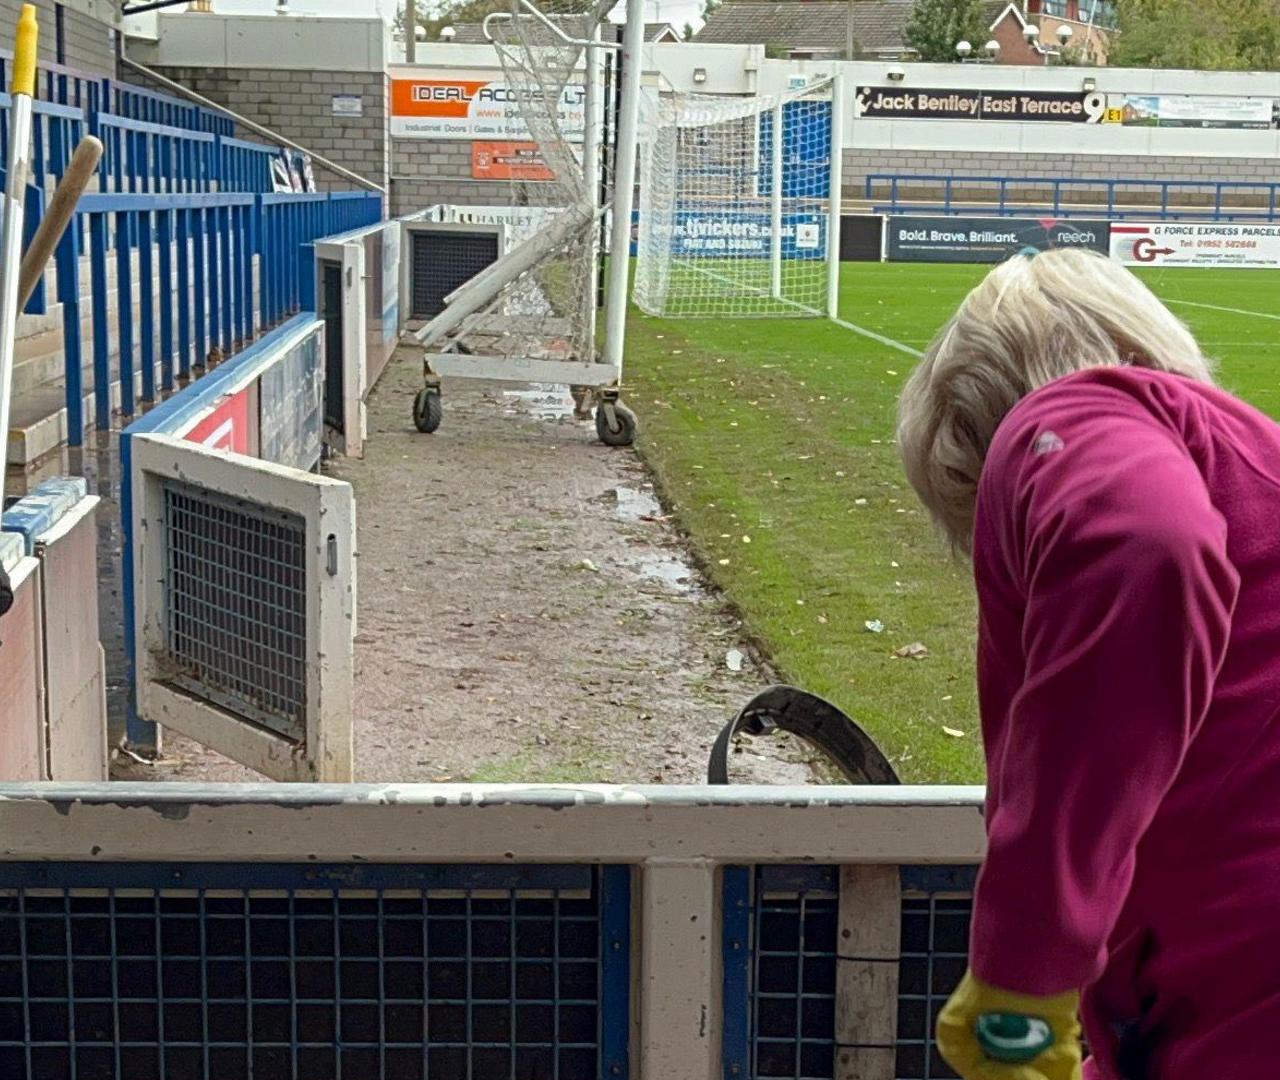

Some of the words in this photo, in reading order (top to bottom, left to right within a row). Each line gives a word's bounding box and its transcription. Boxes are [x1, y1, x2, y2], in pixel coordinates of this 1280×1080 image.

[412, 86, 473, 101] IDEAL
[873, 93, 914, 110] Jack
[918, 94, 979, 115] Bentley
[982, 96, 1017, 113] East
[1020, 97, 1082, 114] Terrace
[445, 124, 467, 133] Doors
[898, 229, 930, 241] Bold.
[930, 230, 969, 242] Brave.
[969, 230, 1019, 243] Brilliant.
[1057, 230, 1096, 243] reech
[1154, 227, 1161, 236] G
[1164, 227, 1194, 236] FORCE
[1197, 227, 1239, 236] EXPRESS
[705, 239, 726, 249] AND
